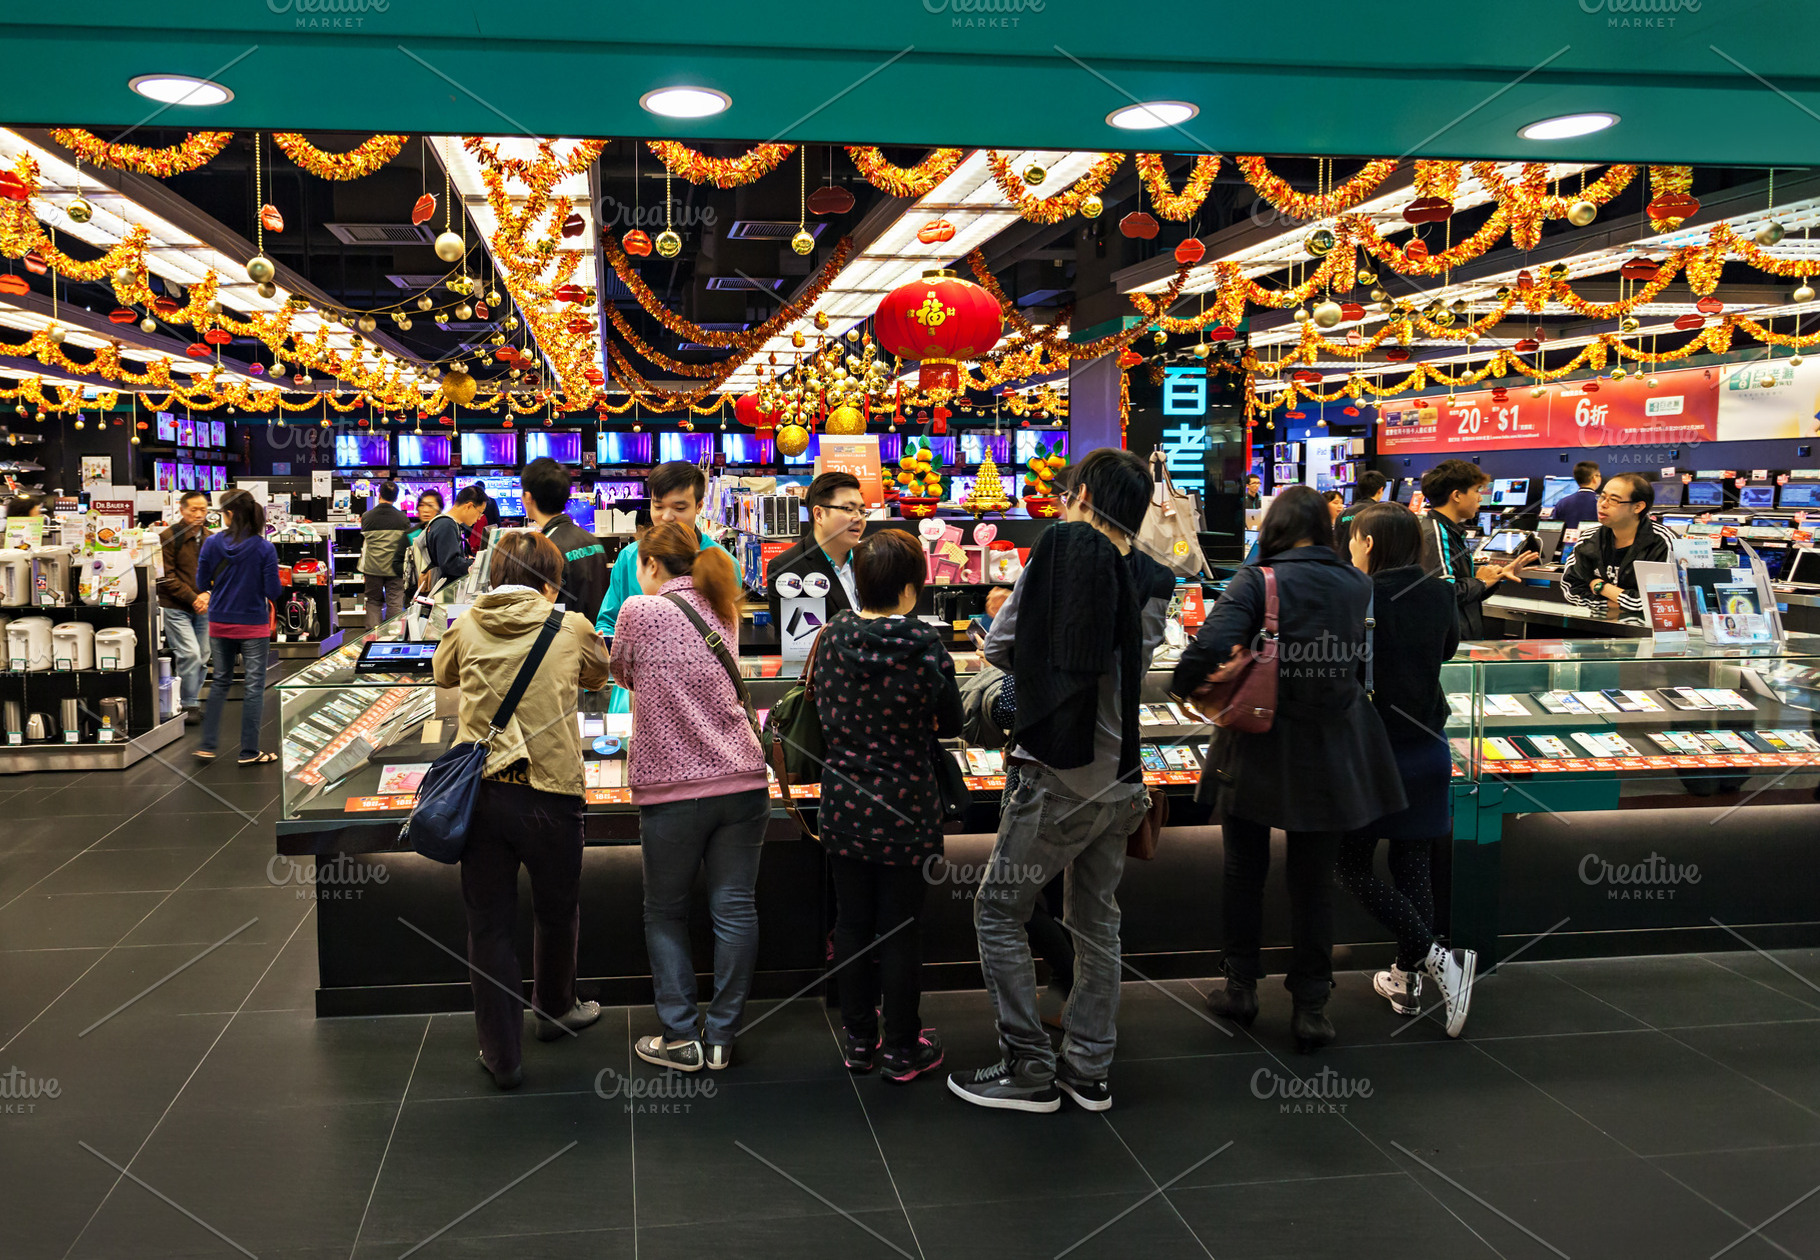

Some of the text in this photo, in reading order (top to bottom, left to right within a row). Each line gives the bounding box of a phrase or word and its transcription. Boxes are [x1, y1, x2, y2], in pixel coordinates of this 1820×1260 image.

[915, 298, 946, 326] 福
[1458, 408, 1481, 434] 20
[1497, 405, 1520, 432] $1
[1575, 398, 1609, 428] 6折
